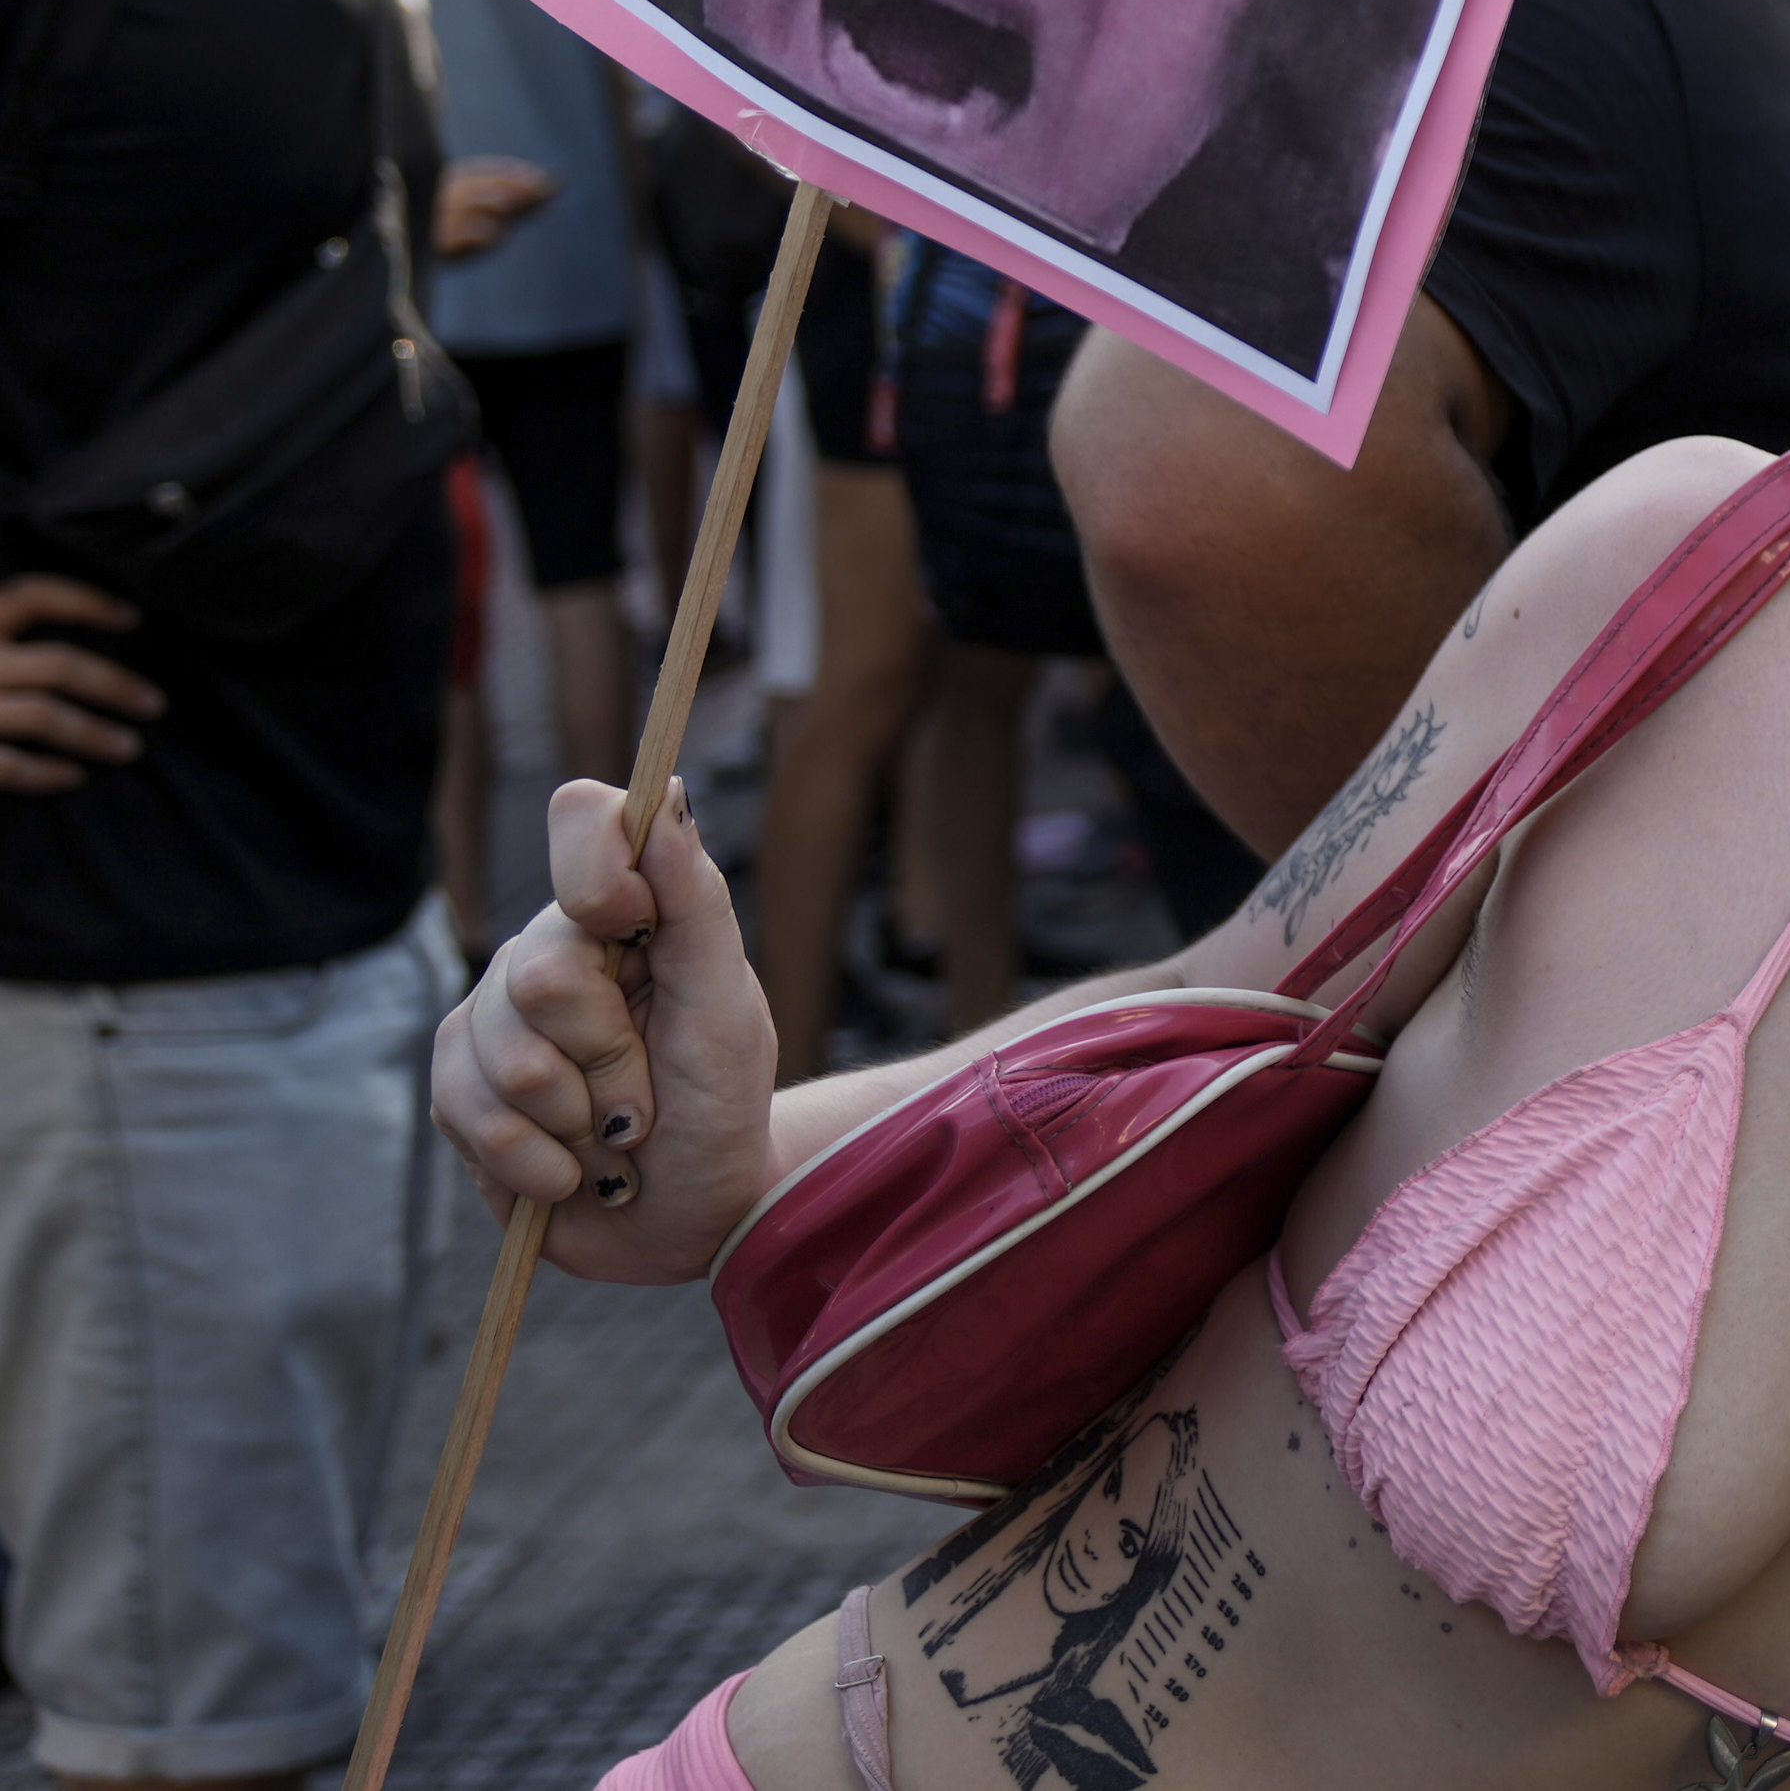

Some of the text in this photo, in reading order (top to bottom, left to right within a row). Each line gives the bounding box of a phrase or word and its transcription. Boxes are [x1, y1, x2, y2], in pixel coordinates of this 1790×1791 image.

[1245, 1549, 1265, 1576] 210
[1200, 1626, 1224, 1650] 180
[1184, 1653, 1206, 1677] 170
[1164, 1678, 1189, 1701] 160
[1144, 1704, 1168, 1727] 150
